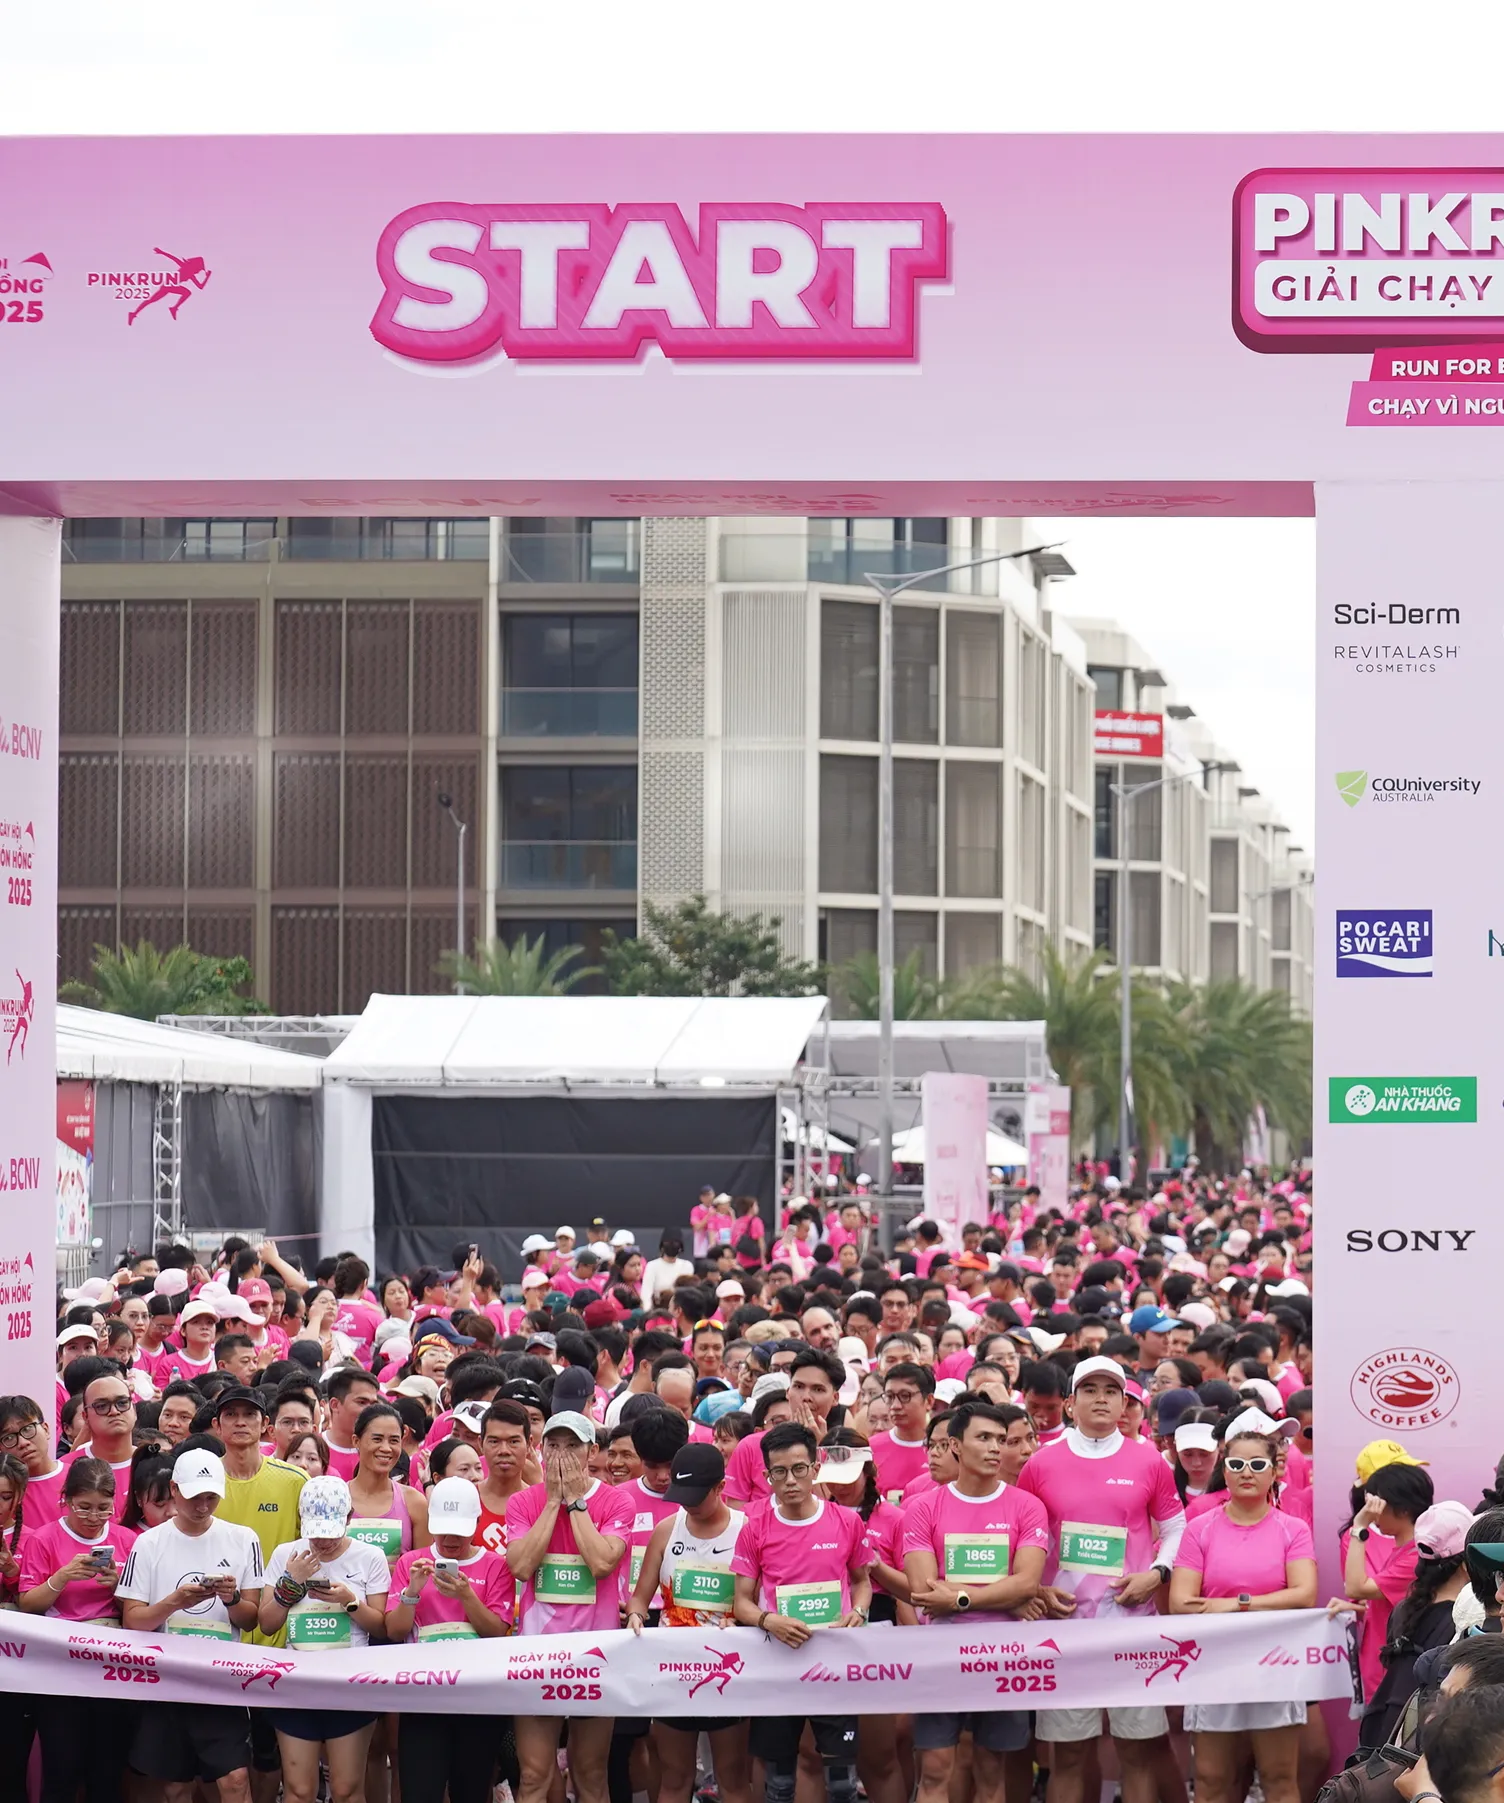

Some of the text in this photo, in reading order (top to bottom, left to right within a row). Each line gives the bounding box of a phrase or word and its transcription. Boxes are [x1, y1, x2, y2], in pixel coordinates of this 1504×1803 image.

[87, 272, 179, 286] PINKRUN
[391, 216, 924, 334] START
[115, 288, 151, 300] 2025
[1271, 266, 1359, 303] GIẢI
[1377, 273, 1494, 309] CHẠY
[0, 300, 44, 323] 25
[1389, 358, 1441, 380] RUN
[1444, 356, 1492, 378] FOR
[1366, 397, 1431, 421] CHẠY
[1434, 395, 1460, 416] VÌ
[1334, 602, 1460, 625] Sci-Derm
[1334, 645, 1458, 659] REVITALASH
[1355, 663, 1436, 673] COSMETICS
[10, 722, 43, 761] BCNV
[1371, 776, 1482, 796] CQUniversity
[1372, 793, 1435, 803] AUSTRALIA
[8, 877, 32, 906] 2025
[1339, 921, 1430, 937] POCARI
[1339, 937, 1422, 953] SWEAT
[1384, 1085, 1452, 1097] NHÀ THUỐC
[1375, 1097, 1461, 1112] AN KHANG
[10, 1158, 40, 1190] BCNV
[1346, 1229, 1476, 1253] SONY
[8, 1311, 31, 1340] 2025
[1358, 1352, 1453, 1386] HIGHLANDS
[1369, 1408, 1442, 1427] COFFEE
[257, 1504, 279, 1512] ACB
[443, 1501, 459, 1512] CAT
[357, 1532, 389, 1543] 9645
[1078, 1538, 1108, 1552] 1023
[965, 1550, 995, 1561] 1865
[553, 1569, 580, 1581] 1618
[675, 1572, 683, 1594] 10KM
[693, 1575, 719, 1589] 3110
[798, 1598, 829, 1611] 2992
[305, 1618, 337, 1629] 3390
[68, 1634, 133, 1651] NGÀY HỘI
[958, 1641, 1026, 1656] NGÀY HỘI
[68, 1647, 157, 1667] NÓN HỒNG
[508, 1648, 572, 1664] NGÀY HỘI
[960, 1655, 1056, 1673] NÓN HỒNG
[1113, 1650, 1179, 1663] PINKRUN
[211, 1659, 275, 1670] PINKRUN
[230, 1667, 256, 1678] 2025
[506, 1662, 601, 1681] NÓN HỒNG
[658, 1660, 723, 1672] PINKRUN
[845, 1662, 914, 1682] BCNV
[1133, 1660, 1160, 1671] 2025
[103, 1664, 162, 1685] 2025
[394, 1668, 462, 1686] BCNV
[677, 1671, 704, 1683] 2025
[540, 1683, 603, 1701] 2025
[995, 1675, 1058, 1694] 2025
